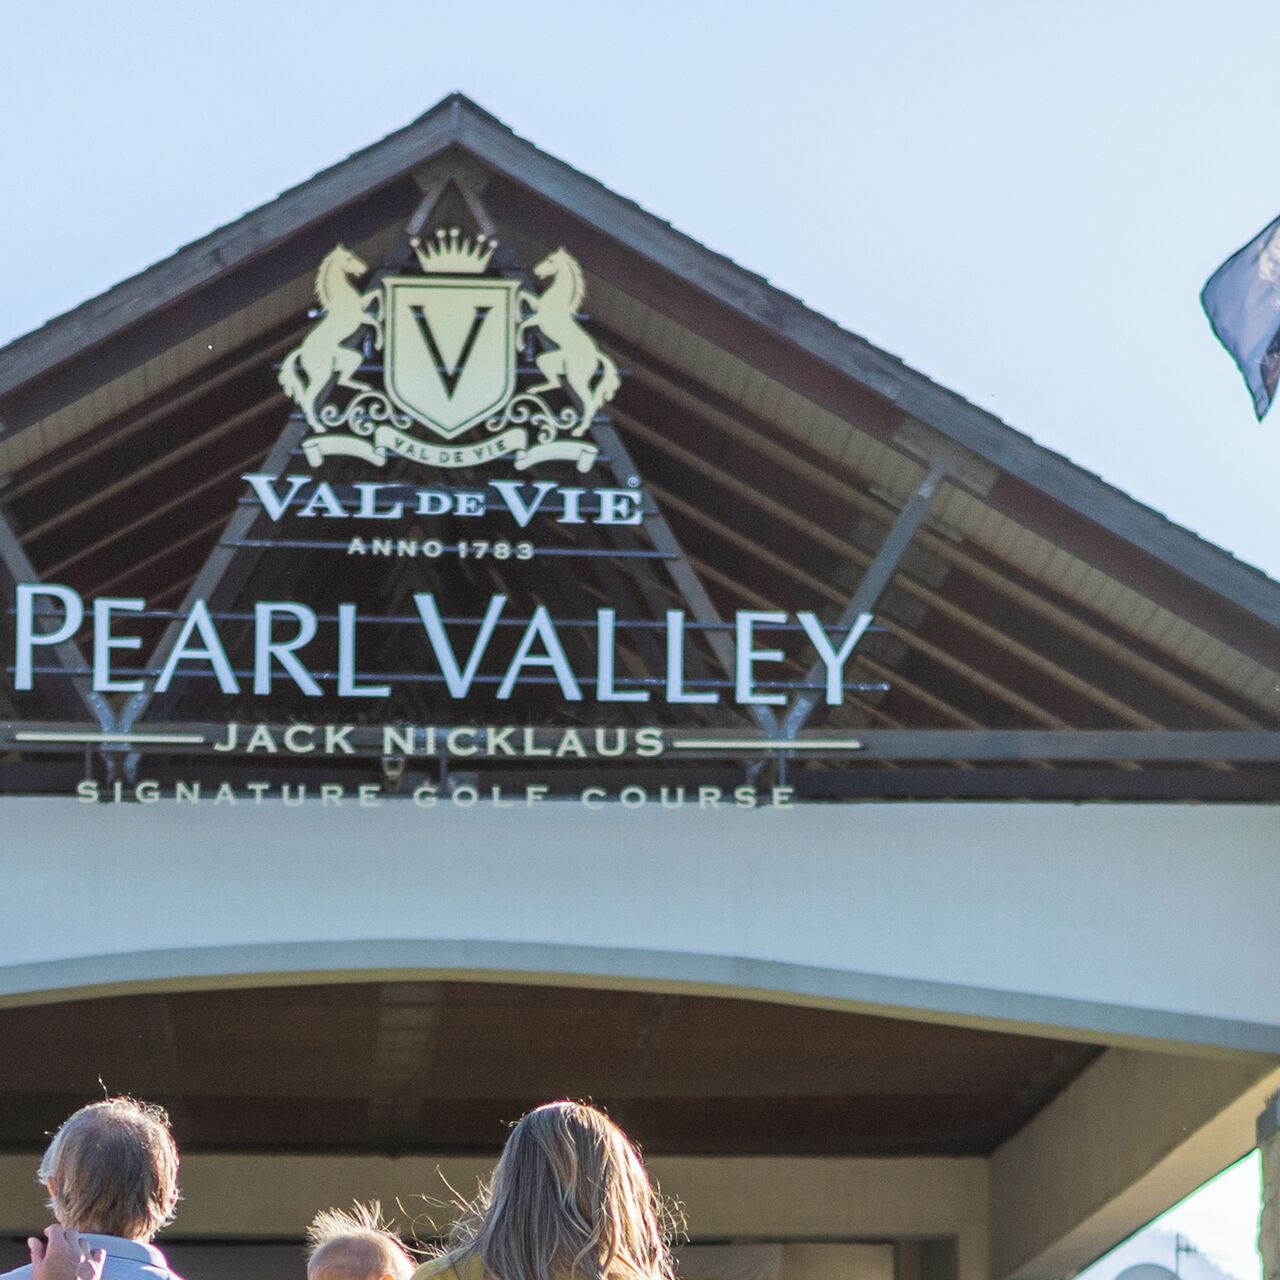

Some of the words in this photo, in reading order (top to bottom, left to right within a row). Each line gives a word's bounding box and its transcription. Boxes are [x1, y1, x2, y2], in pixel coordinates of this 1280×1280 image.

[409, 305, 493, 400] V
[394, 437, 429, 461] VAL
[439, 451, 463, 463] DE
[473, 440, 506, 460] VIE
[241, 473, 404, 522] VAL
[415, 491, 486, 517] DE
[488, 480, 643, 527] VIE
[347, 537, 444, 559] ANNO
[457, 541, 535, 561] 1783
[14, 583, 392, 697] PEARL
[413, 593, 874, 705] VALLEY
[213, 723, 356, 755] JACK
[382, 725, 665, 758] NICKLAUS
[76, 779, 382, 808] SIGNATURE
[412, 785, 549, 809] GOLF
[580, 786, 794, 811] COURSE
